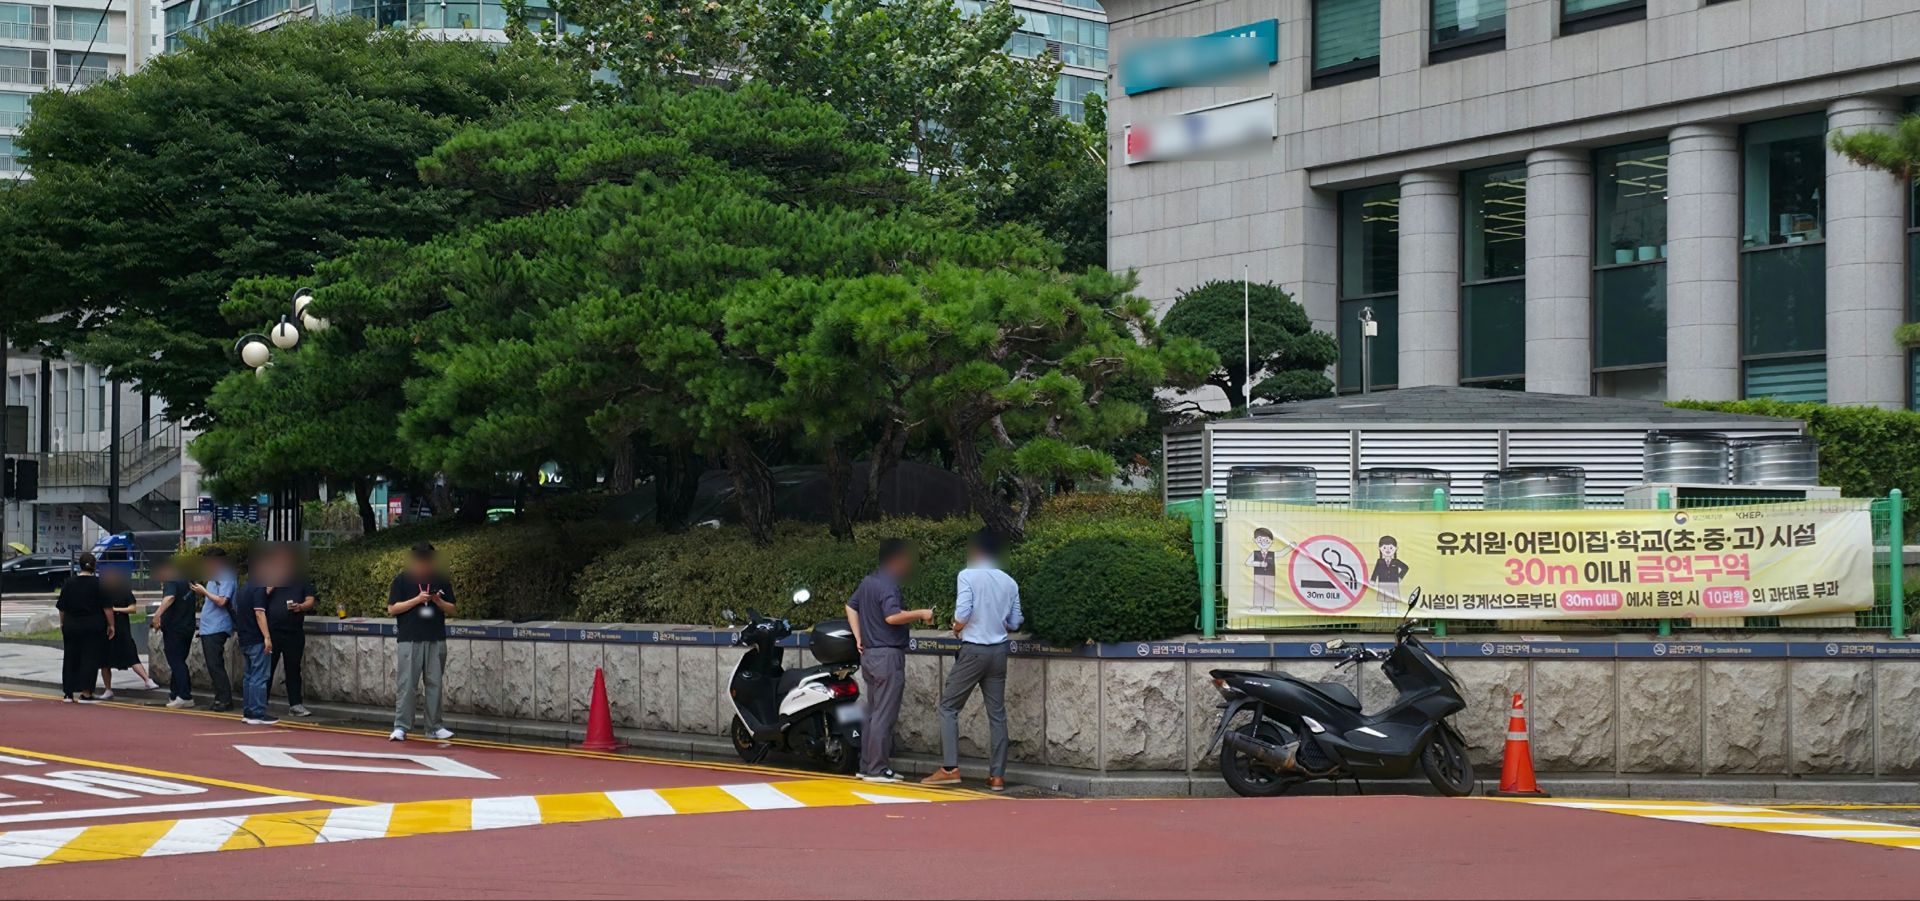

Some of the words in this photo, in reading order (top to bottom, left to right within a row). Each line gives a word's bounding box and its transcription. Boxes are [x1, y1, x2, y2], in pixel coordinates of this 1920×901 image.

[1769, 523, 1816, 548] 시설
[1504, 557, 1579, 586] 30m
[1583, 560, 1632, 584] 이내
[1636, 553, 1751, 583] 금연구역
[1306, 591, 1324, 599] 30m
[1326, 592, 1340, 600] 이내
[1420, 594, 1459, 610] 시설의
[1462, 592, 1557, 610] 경계선으로부터
[1565, 594, 1593, 606] 30m
[1596, 593, 1618, 606] 이내
[1626, 591, 1653, 607] 에서
[1656, 590, 1683, 607] 흡연
[1687, 590, 1700, 606] 시
[1707, 590, 1745, 604] 10만원
[1752, 588, 1765, 603] 의
[1768, 585, 1808, 603] 과태료
[1812, 580, 1839, 598] 부과
[1152, 645, 1185, 655] 금연구역
[1497, 644, 1530, 654] 금연구역
